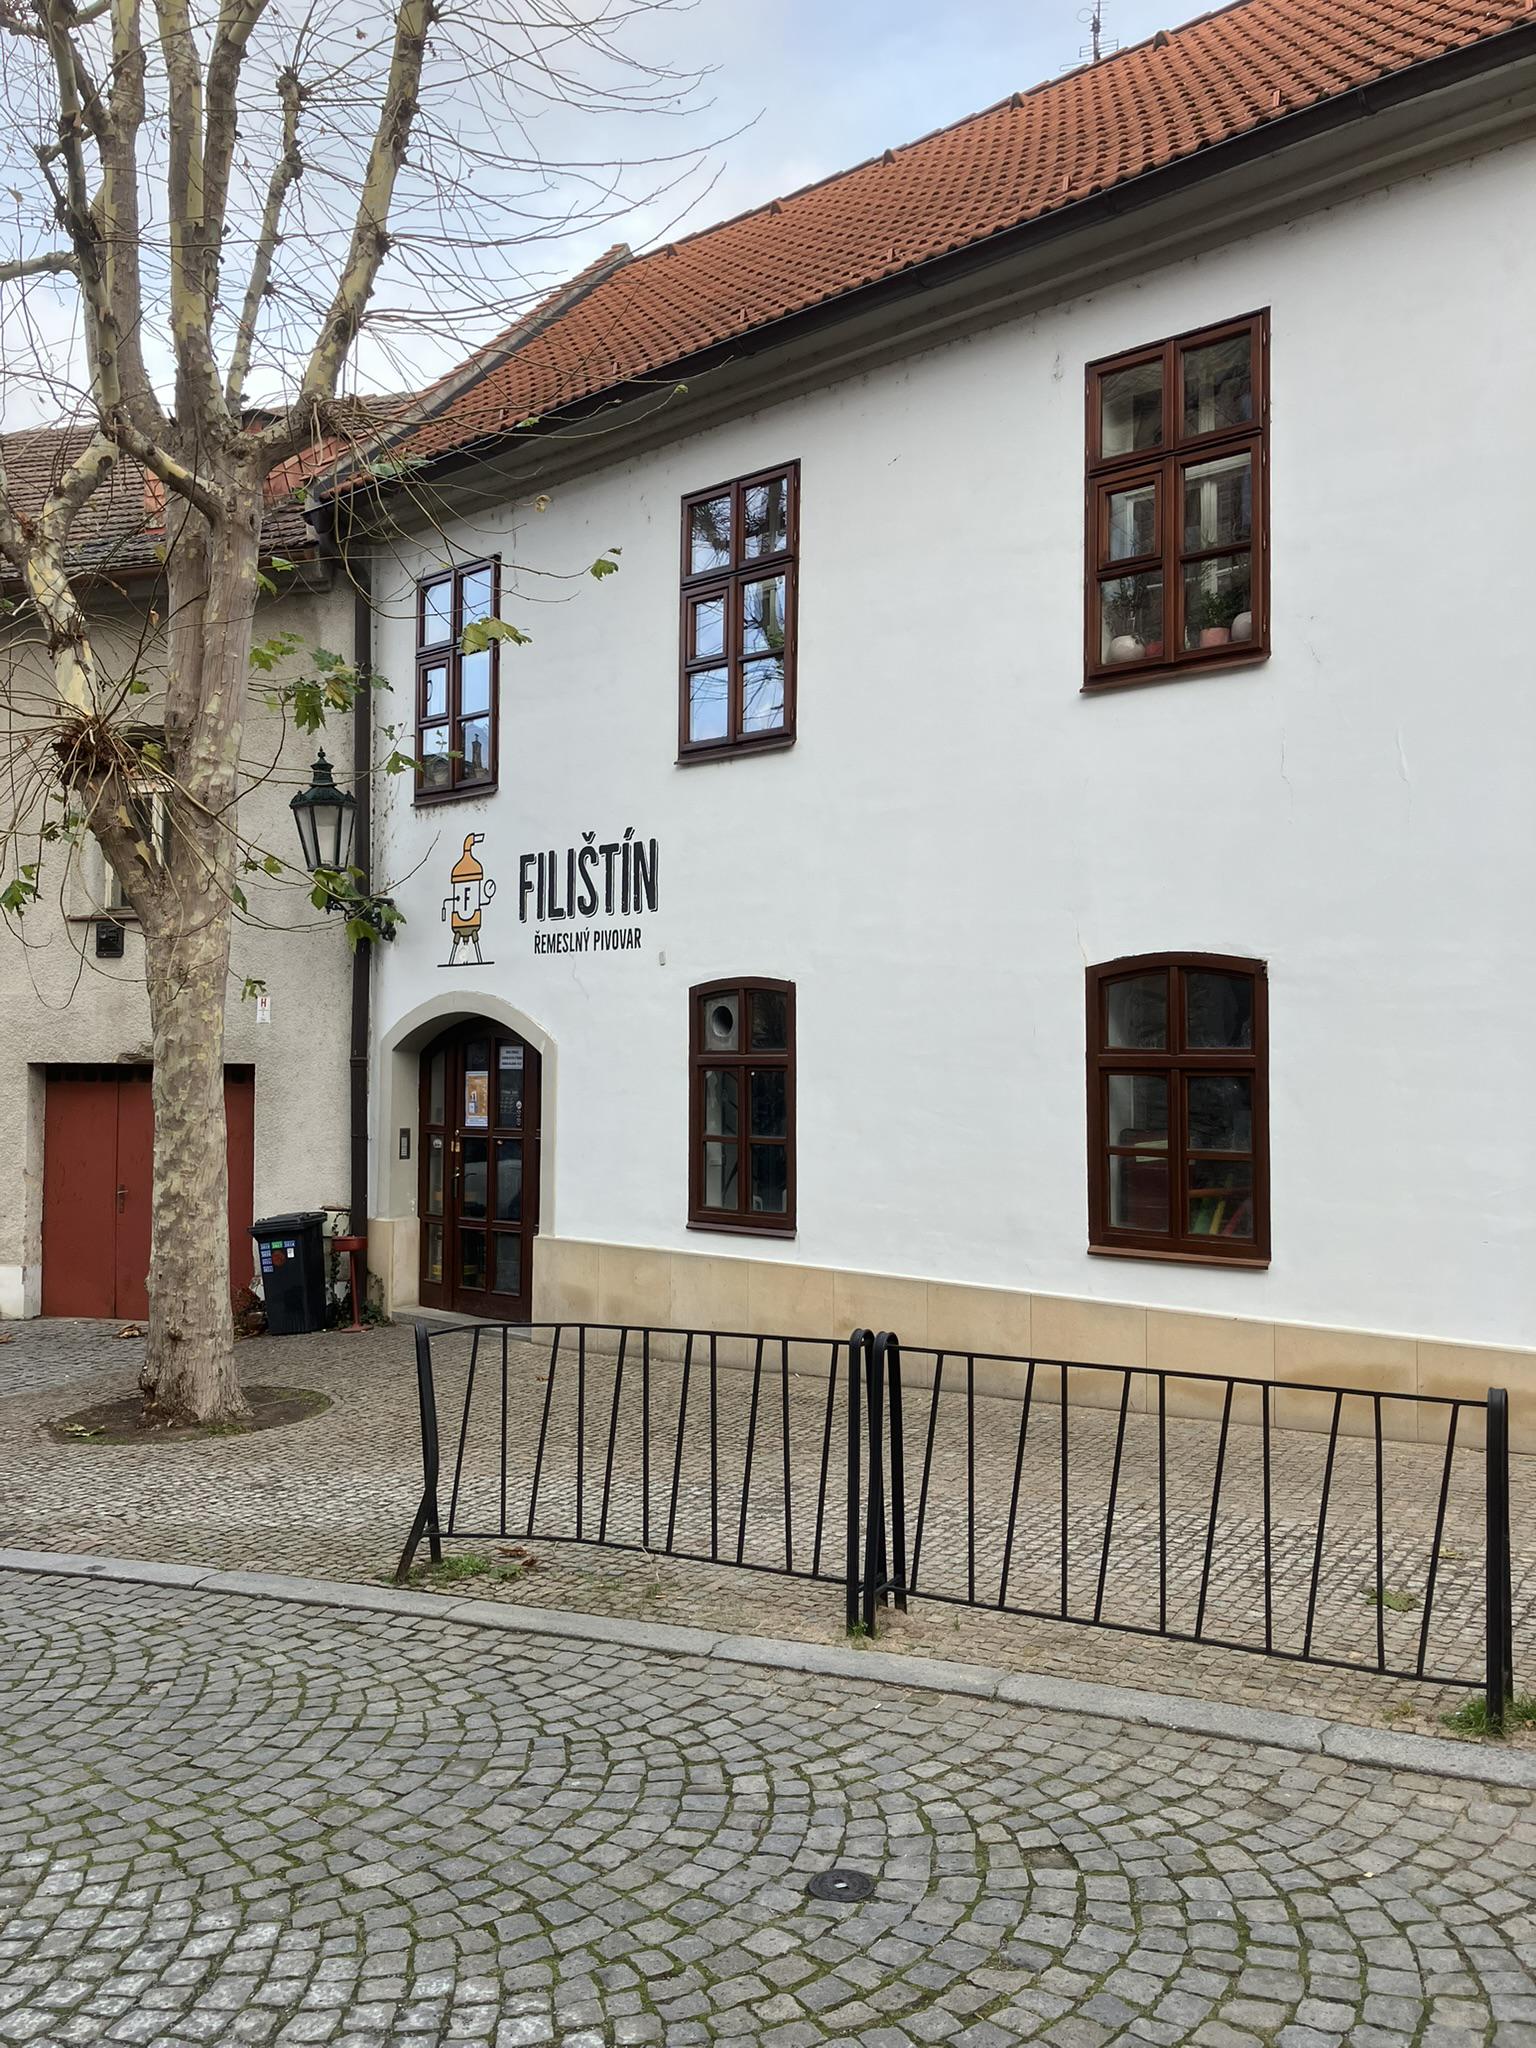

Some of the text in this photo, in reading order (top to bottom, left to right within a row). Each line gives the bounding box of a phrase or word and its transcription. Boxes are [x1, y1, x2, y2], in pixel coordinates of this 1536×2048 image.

[518, 826, 659, 923] FILIŠTÍN
[463, 887, 471, 911] F
[534, 927, 642, 954] ŘEMESLNÝ PIVOVAR
[260, 997, 267, 1008] H
